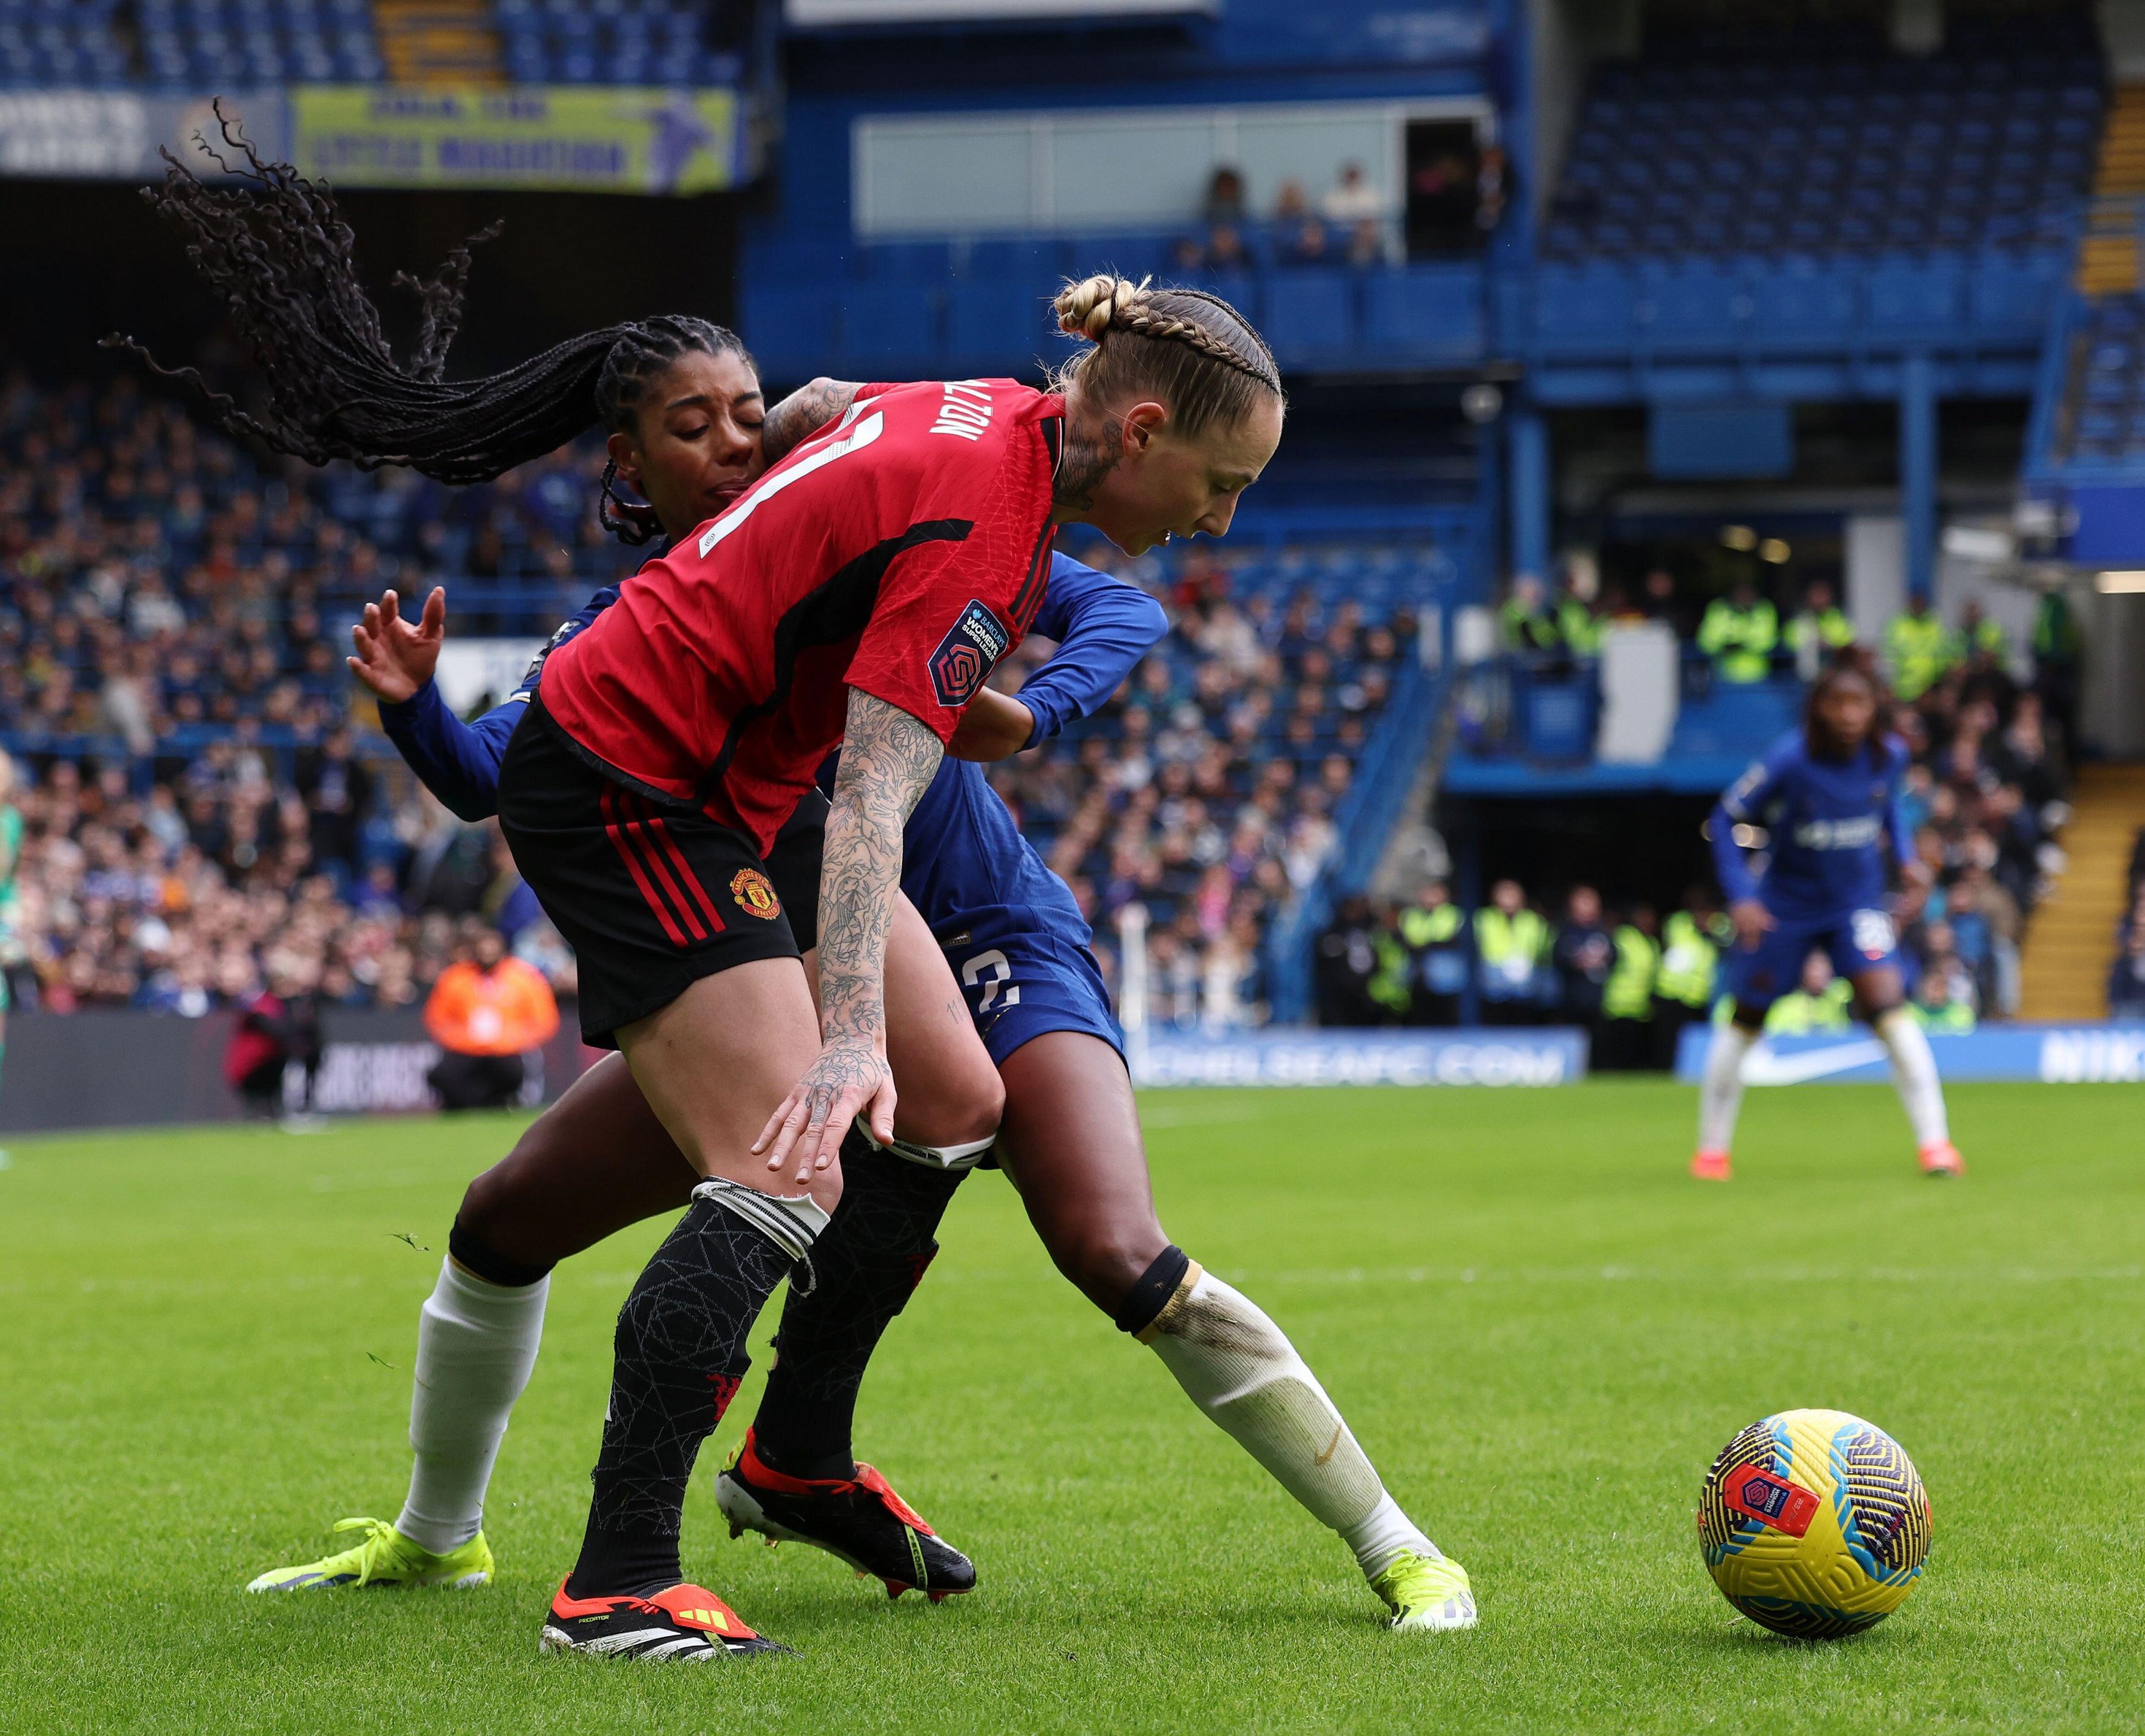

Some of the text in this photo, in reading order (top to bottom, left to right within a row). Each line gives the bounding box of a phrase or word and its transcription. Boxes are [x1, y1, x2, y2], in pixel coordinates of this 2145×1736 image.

[962, 624, 996, 662] SUPER LEAGUE
[966, 616, 999, 656] WOMEN'S
[979, 616, 1006, 649] BARCLAYS
[735, 872, 769, 892] MANCHESTER
[754, 907, 778, 917] UNITED
[578, 1615, 609, 1624] PREDATOR
